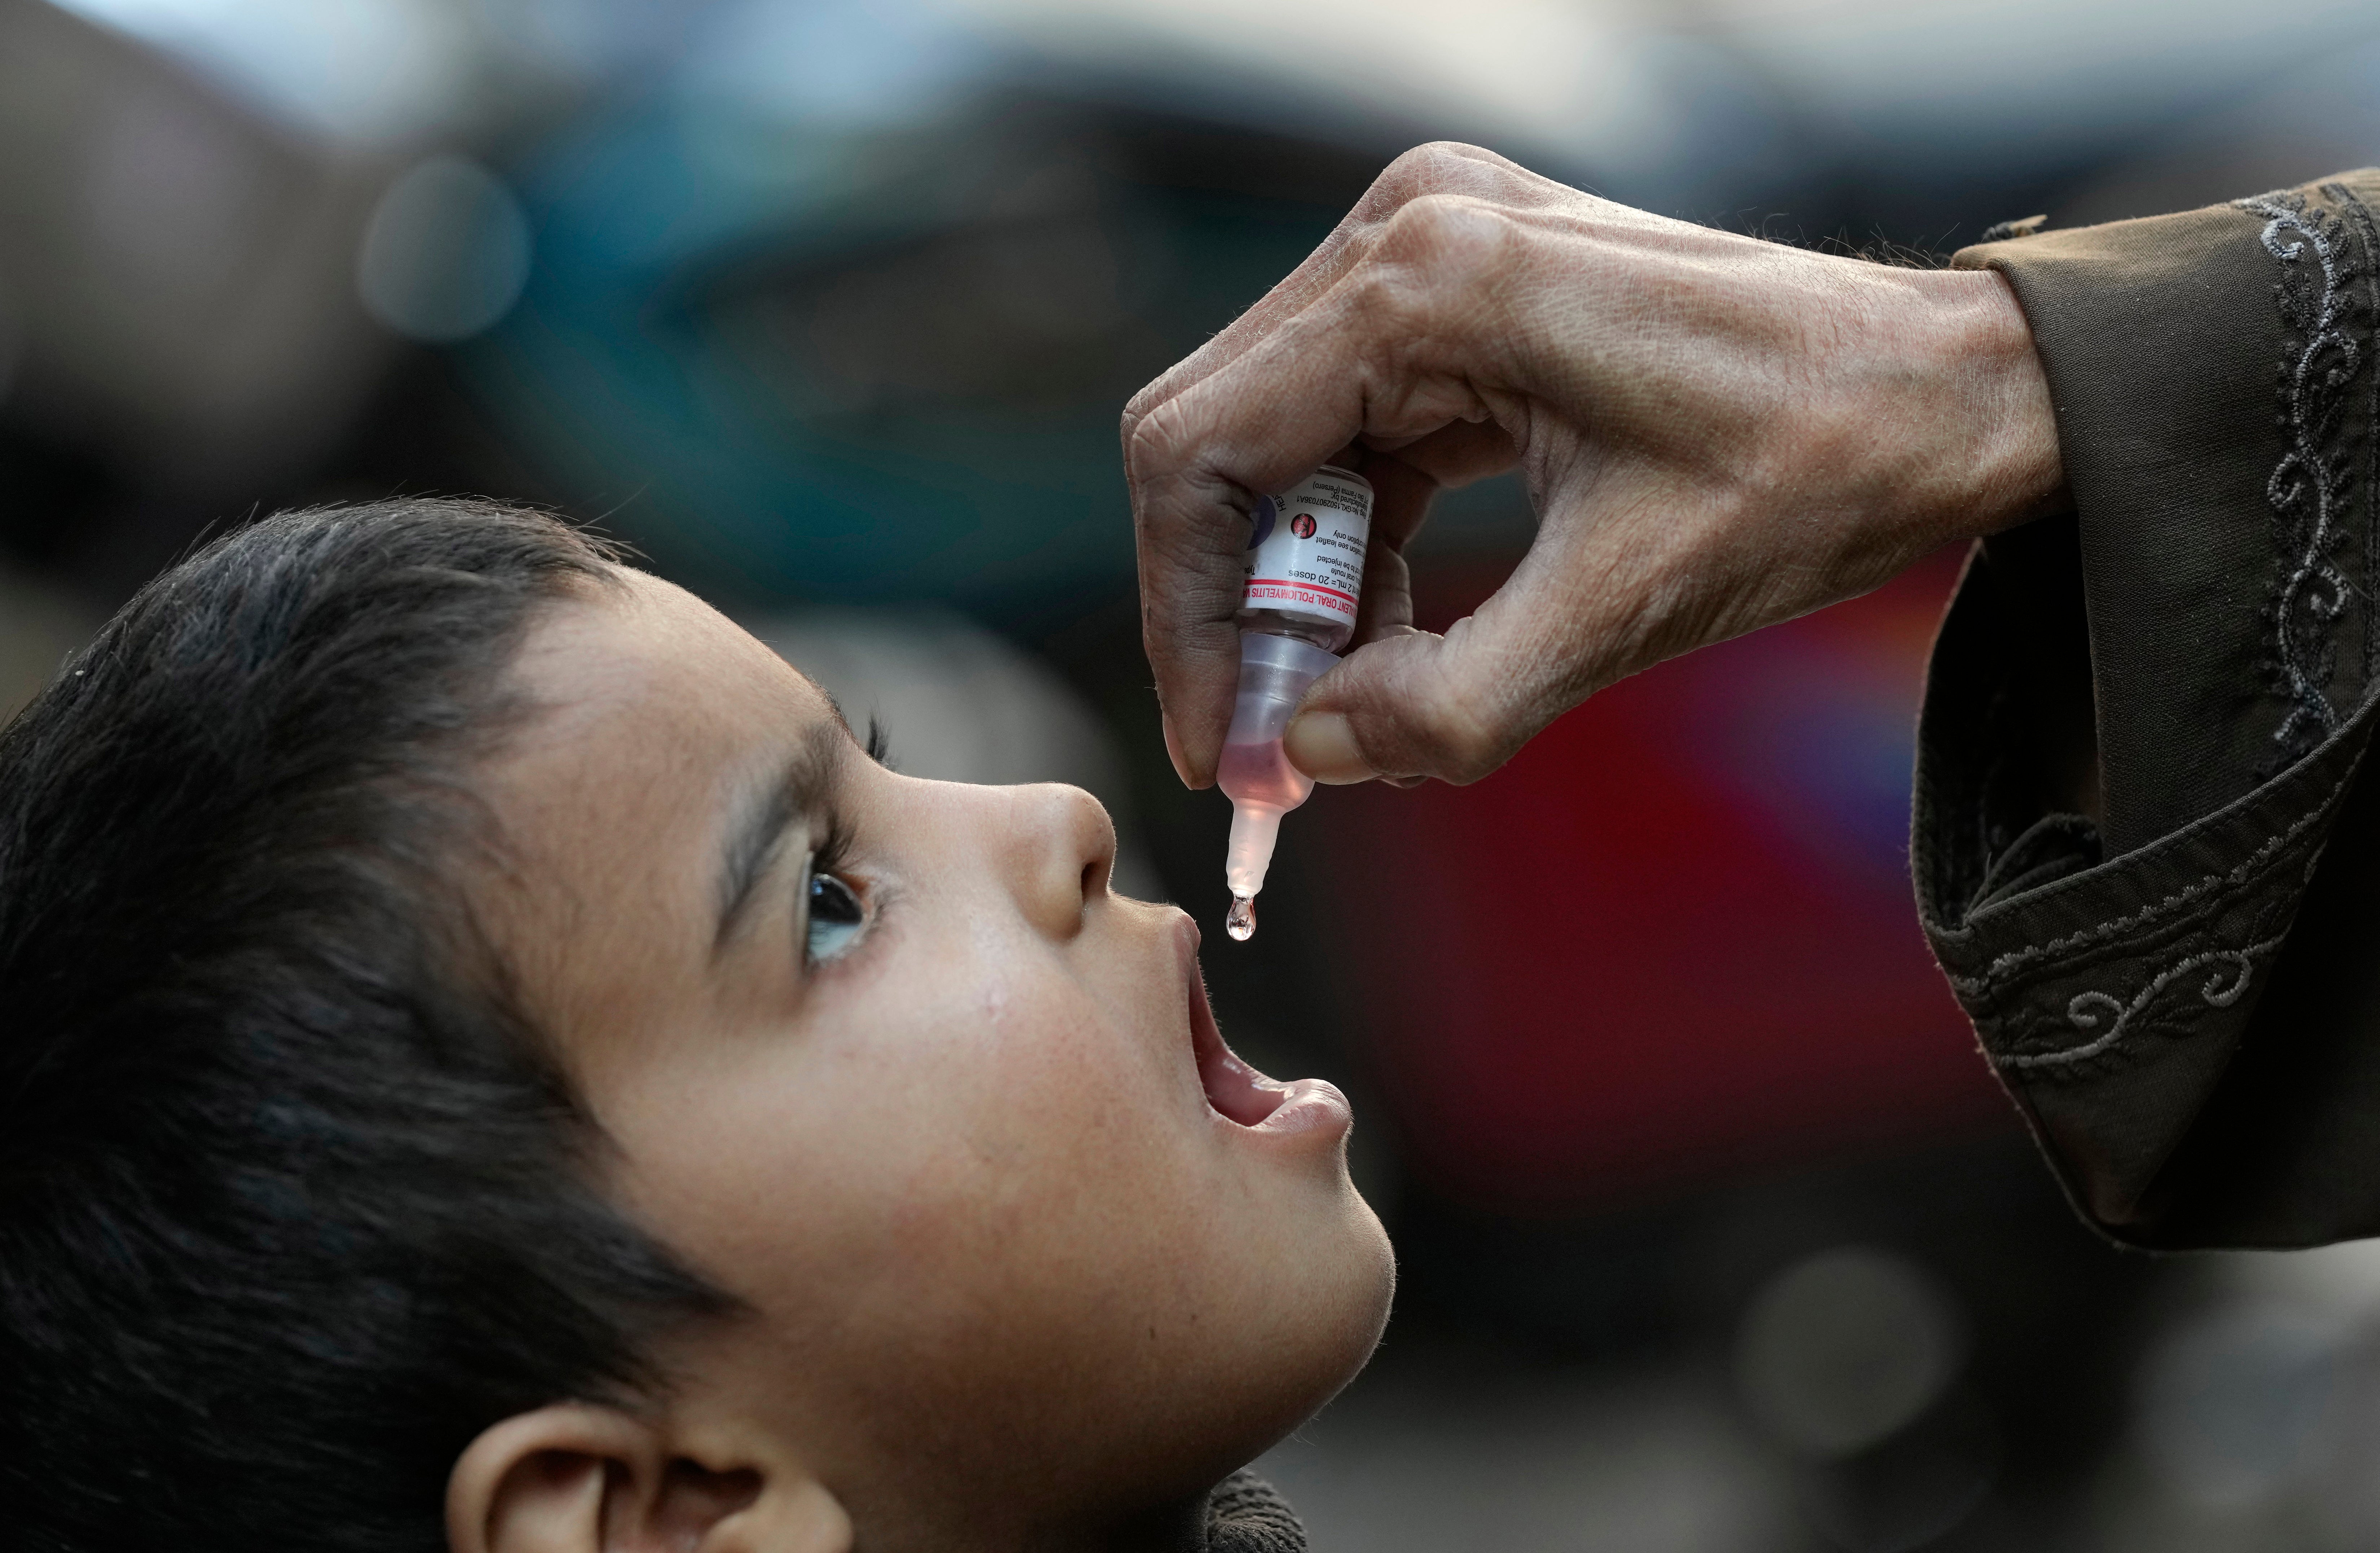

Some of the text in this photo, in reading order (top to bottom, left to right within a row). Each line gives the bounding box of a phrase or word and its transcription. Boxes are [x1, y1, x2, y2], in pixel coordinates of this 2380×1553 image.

[1313, 481, 1340, 494] (Persero)
[1331, 493, 1339, 501] by:
[1342, 488, 1356, 499] Farma
[1272, 495, 1286, 511] HEA
[1340, 496, 1367, 512] Manufactured
[1364, 496, 1369, 505] PT
[1333, 530, 1346, 538] only
[1316, 537, 1336, 547] leaflet
[1317, 555, 1342, 568] injected
[1288, 570, 1316, 581] doses
[1331, 568, 1346, 577] route
[1319, 575, 1329, 585] 20
[1348, 584, 1351, 592] 2
[1252, 588, 1314, 603] POLIOMYELITIS
[1317, 595, 1337, 609] ORAL
